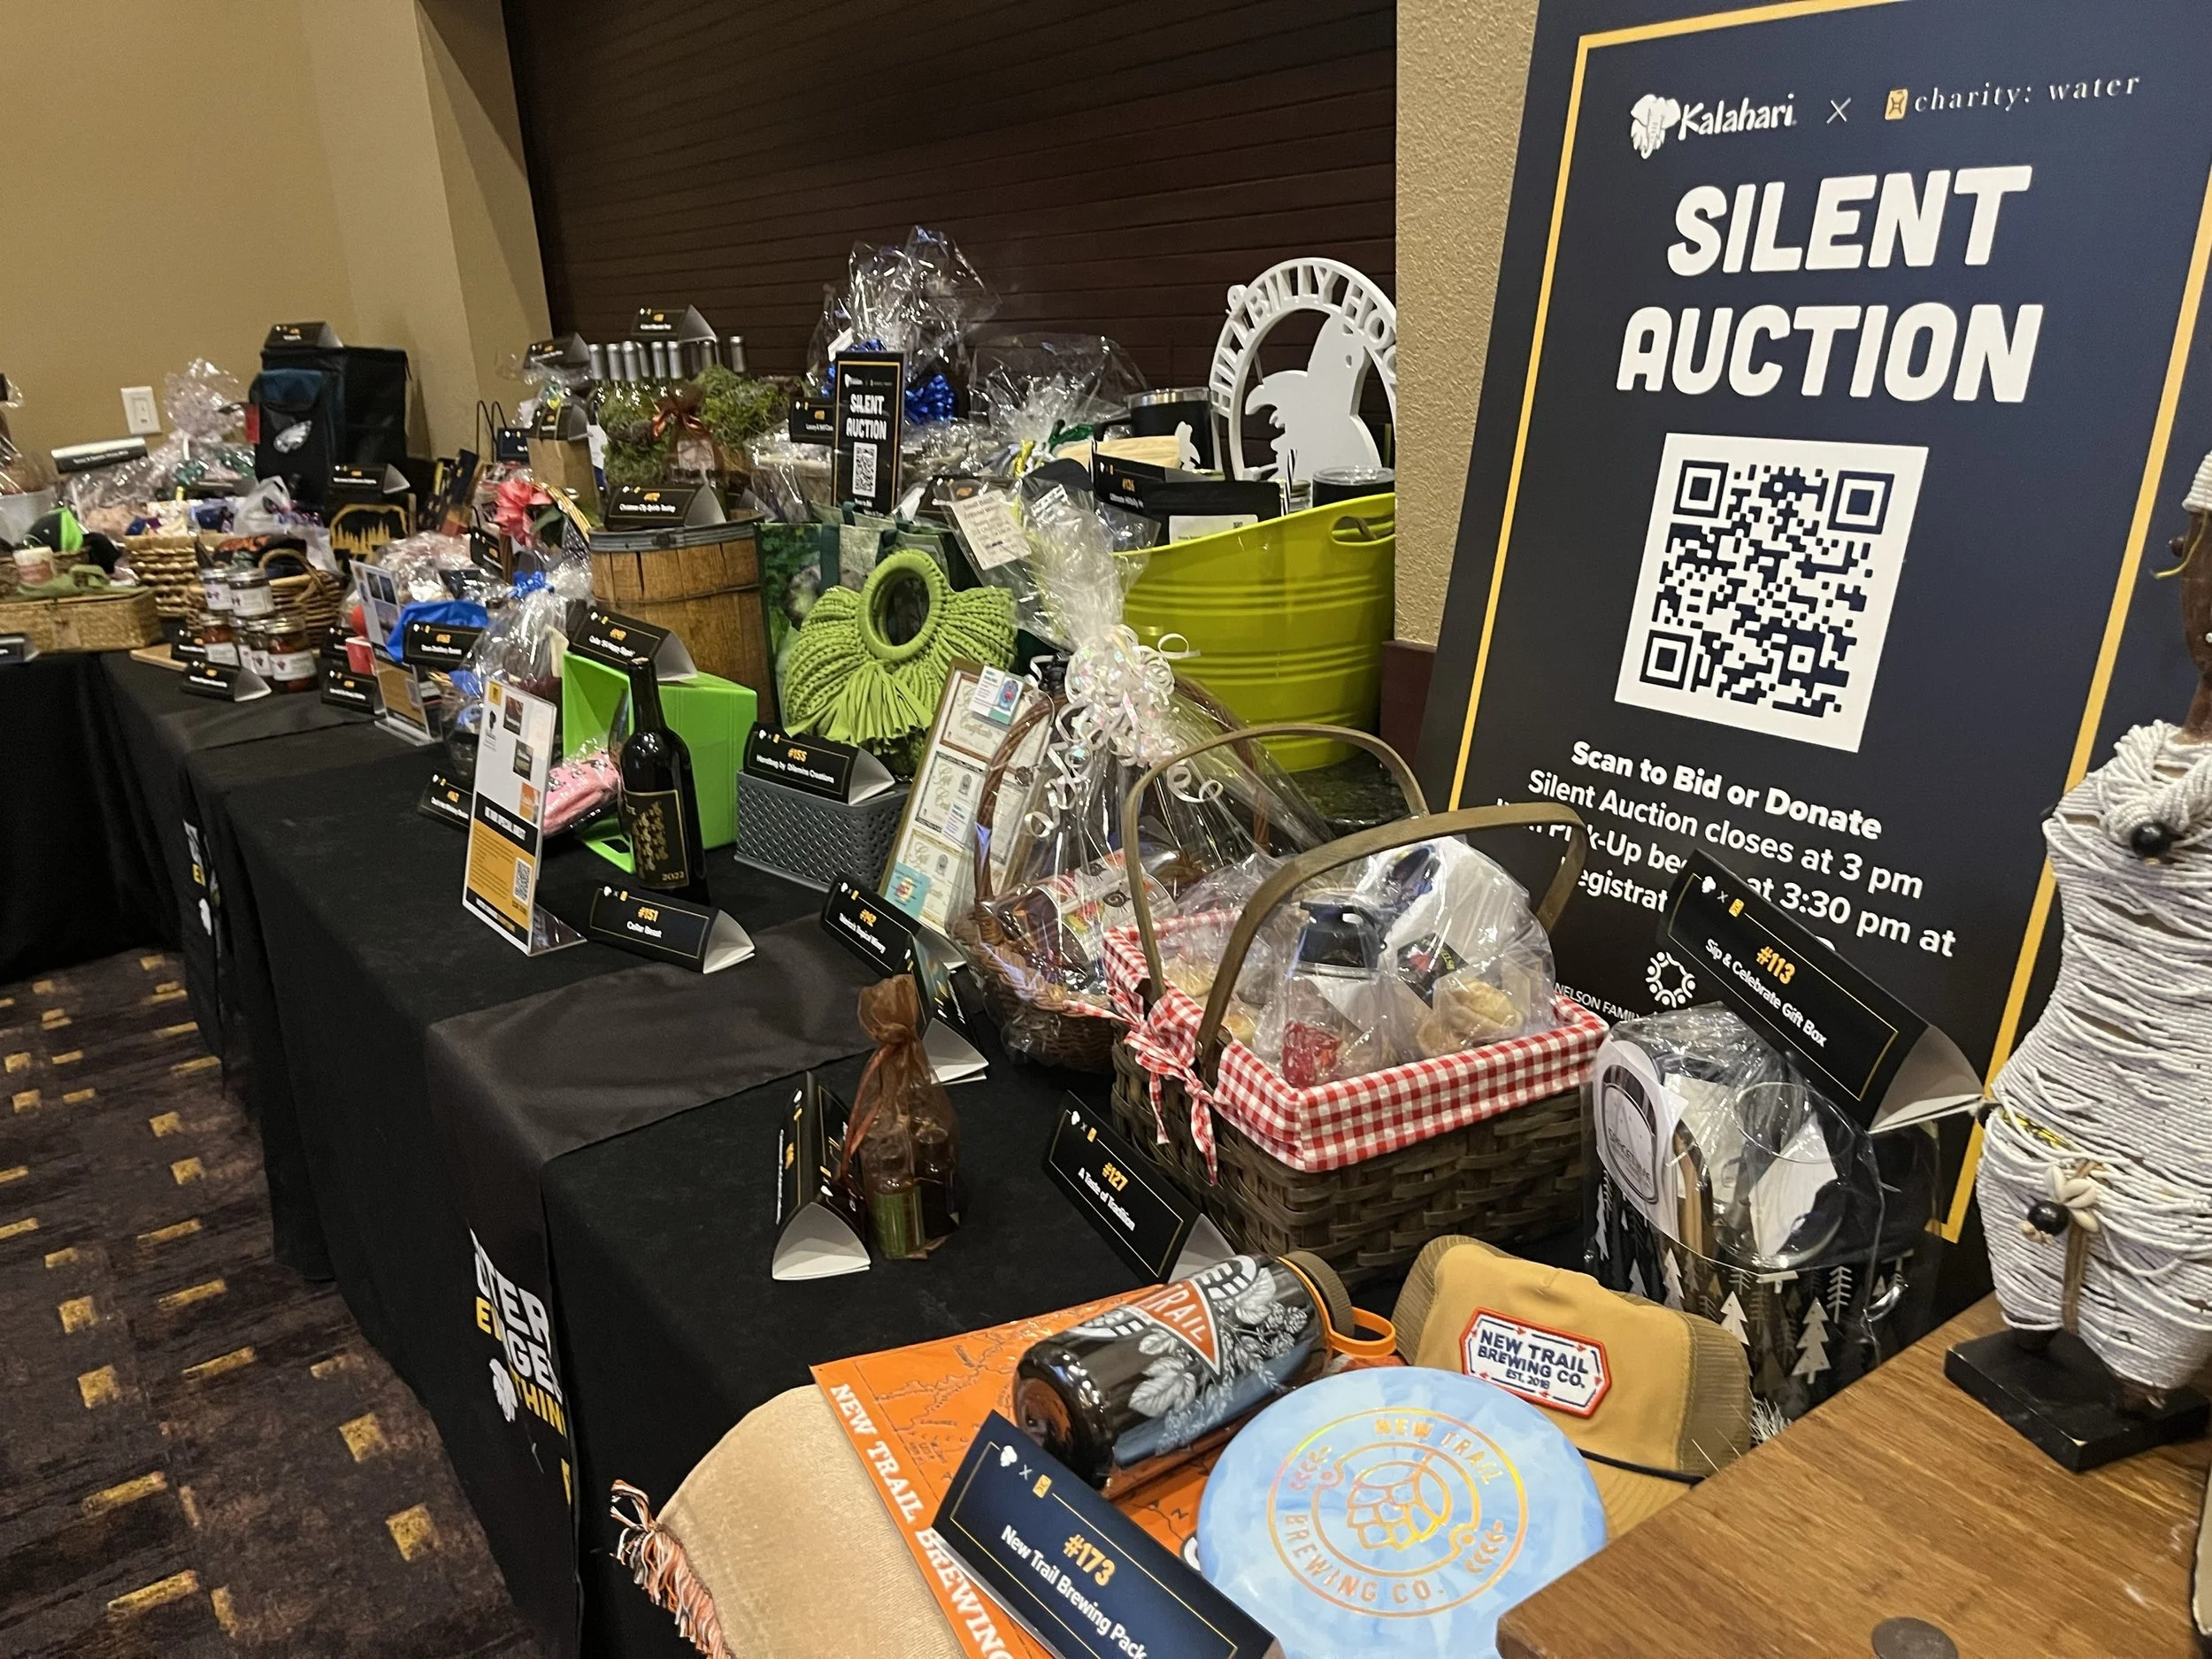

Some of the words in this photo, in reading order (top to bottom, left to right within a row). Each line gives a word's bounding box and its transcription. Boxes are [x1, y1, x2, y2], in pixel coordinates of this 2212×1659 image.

[1678, 93, 1796, 140] Kalahari
[1914, 84, 2033, 112] charity:
[2047, 74, 2139, 101] water
[1667, 165, 2032, 276] SILENT
[1616, 302, 2044, 403] AUCTION
[846, 418, 887, 440] AUCTION
[850, 394, 884, 415] SILENT
[1572, 741, 1632, 778] Scan
[1640, 758, 1667, 786] to
[1672, 765, 1723, 799] Bid
[1727, 781, 1760, 809] or
[1764, 787, 1882, 841] Donate
[1527, 769, 1595, 809] Silent
[1598, 788, 1698, 837] Auction
[1705, 816, 1793, 864] closes
[1801, 848, 1832, 875] at
[1839, 853, 1863, 881] 3
[1867, 865, 1924, 899] pm
[1779, 882, 1851, 924] 3:30
[1856, 910, 1911, 938] pm
[1918, 927, 1956, 957] at
[1755, 946, 1795, 985] #113
[1555, 982, 1601, 1010] NELSON
[1705, 938, 1723, 961] Sip
[1722, 953, 1732, 968] &
[1732, 961, 1781, 1009] Celebrate
[1781, 1002, 1804, 1028] Gift
[1802, 1019, 1827, 1048] Box
[1078, 1167, 1086, 1179] A
[1102, 1162, 1128, 1192] #127
[1478, 1345, 1552, 1378] BREWING
[1557, 1370, 1586, 1389] CO.
[1479, 1329, 1523, 1355] NEW
[1528, 1344, 1589, 1374] TRAIL
[1506, 1370, 1525, 1384] EST.
[830, 1384, 879, 1439] NEW
[866, 1441, 926, 1525] TRAIL
[1374, 1418, 1434, 1439] NEW
[1440, 1429, 1504, 1486] TRAIL
[1063, 1534, 1116, 1586] #173
[1284, 1513, 1379, 1605] BREWING
[1001, 1525, 1029, 1560] New
[1030, 1550, 1061, 1586] Trail
[1056, 1574, 1111, 1636] Brewing
[1110, 1623, 1148, 1659] Pack
